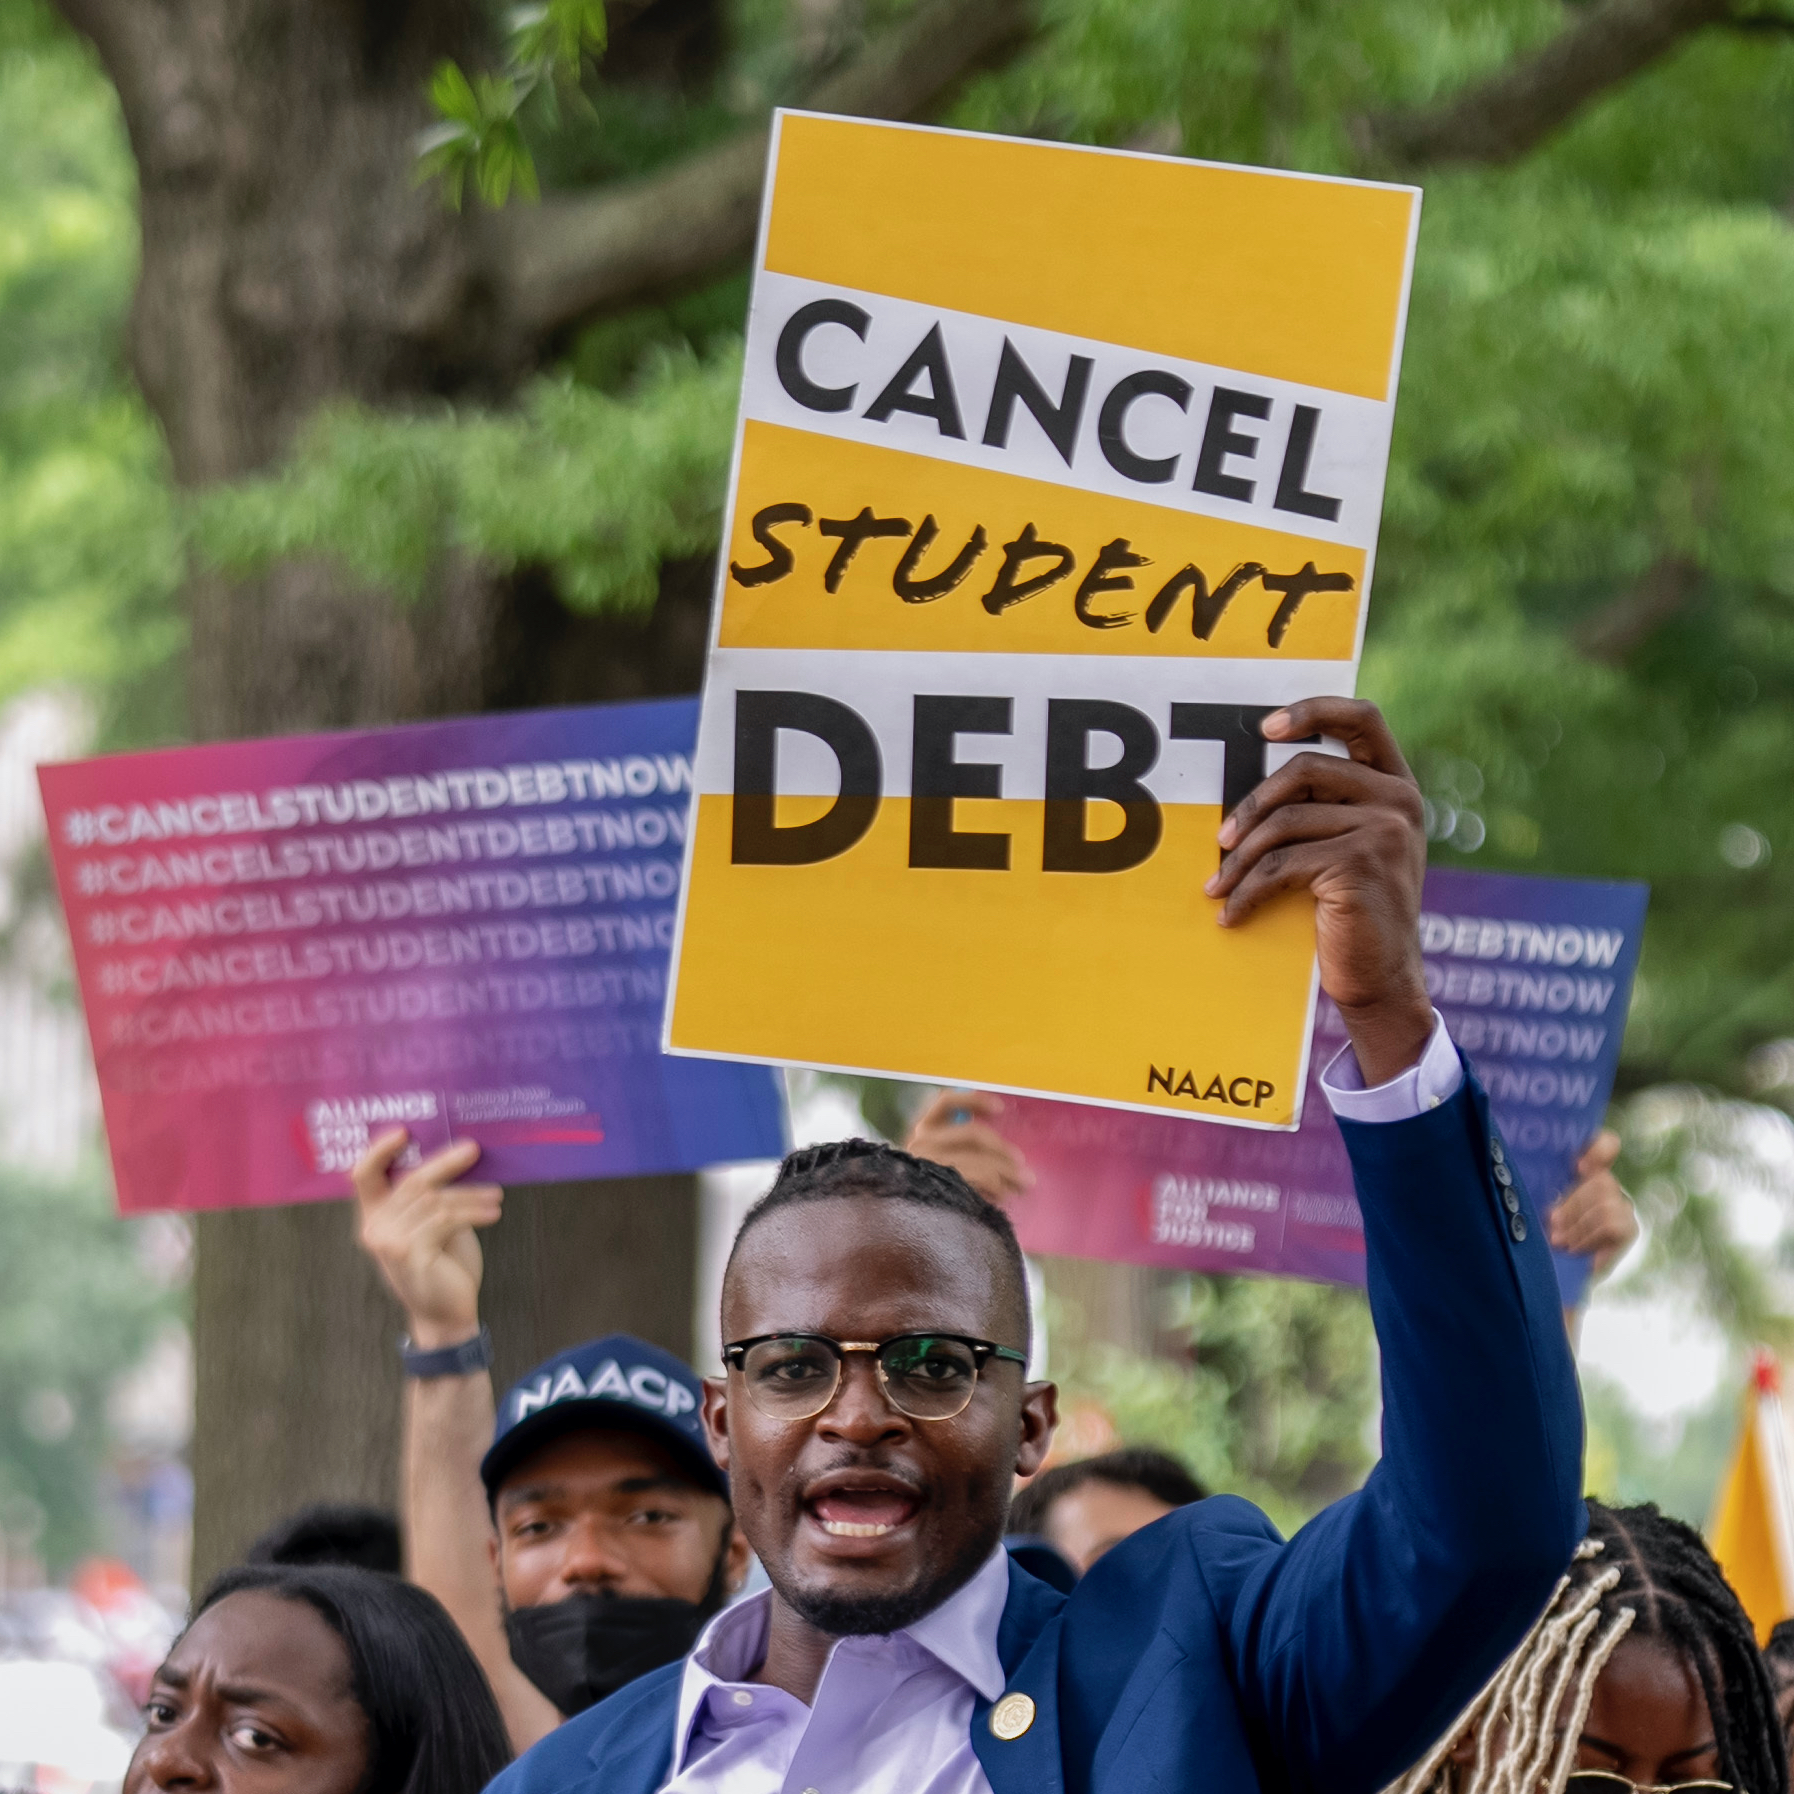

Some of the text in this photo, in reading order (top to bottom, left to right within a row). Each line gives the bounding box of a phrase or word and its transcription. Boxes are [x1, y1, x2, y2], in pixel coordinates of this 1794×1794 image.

[776, 298, 1343, 523] CANCEL
[730, 502, 1356, 649] STUDENT
[731, 689, 1322, 873] DEBT
[89, 861, 681, 945] #CANCELSTUDENTDEBTNO
[311, 1091, 437, 1125] ALLIANCE
[1147, 1064, 1274, 1109] NAACP
[1157, 1172, 1281, 1213] ALLIANCE
[1156, 1220, 1256, 1253] JUSTICE
[512, 1359, 696, 1424] NAACP
